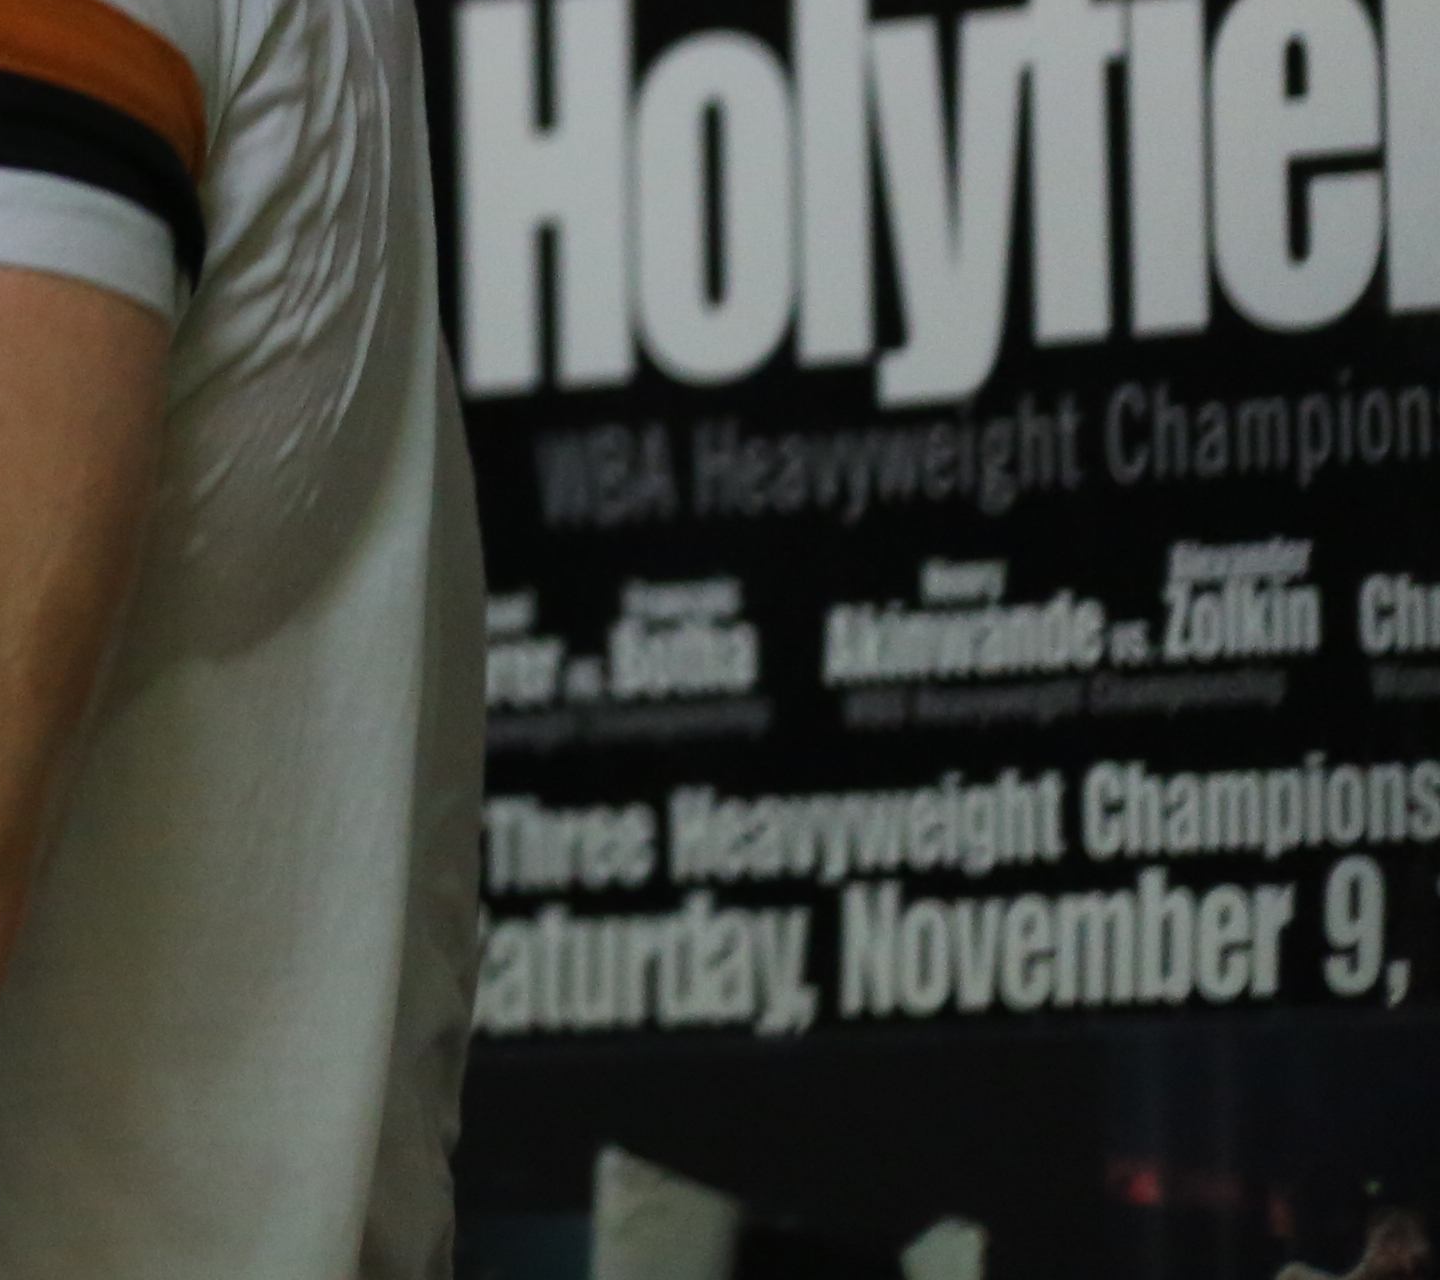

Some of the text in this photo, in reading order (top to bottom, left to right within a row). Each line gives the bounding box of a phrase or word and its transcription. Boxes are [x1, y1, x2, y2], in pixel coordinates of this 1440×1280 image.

[690, 395, 1082, 523] Heavyweight
[1162, 570, 1322, 664] Zolkin
[486, 793, 657, 895] Three
[668, 770, 1068, 888] Heavyweight
[477, 853, 1412, 1038] aturday, November 9,
